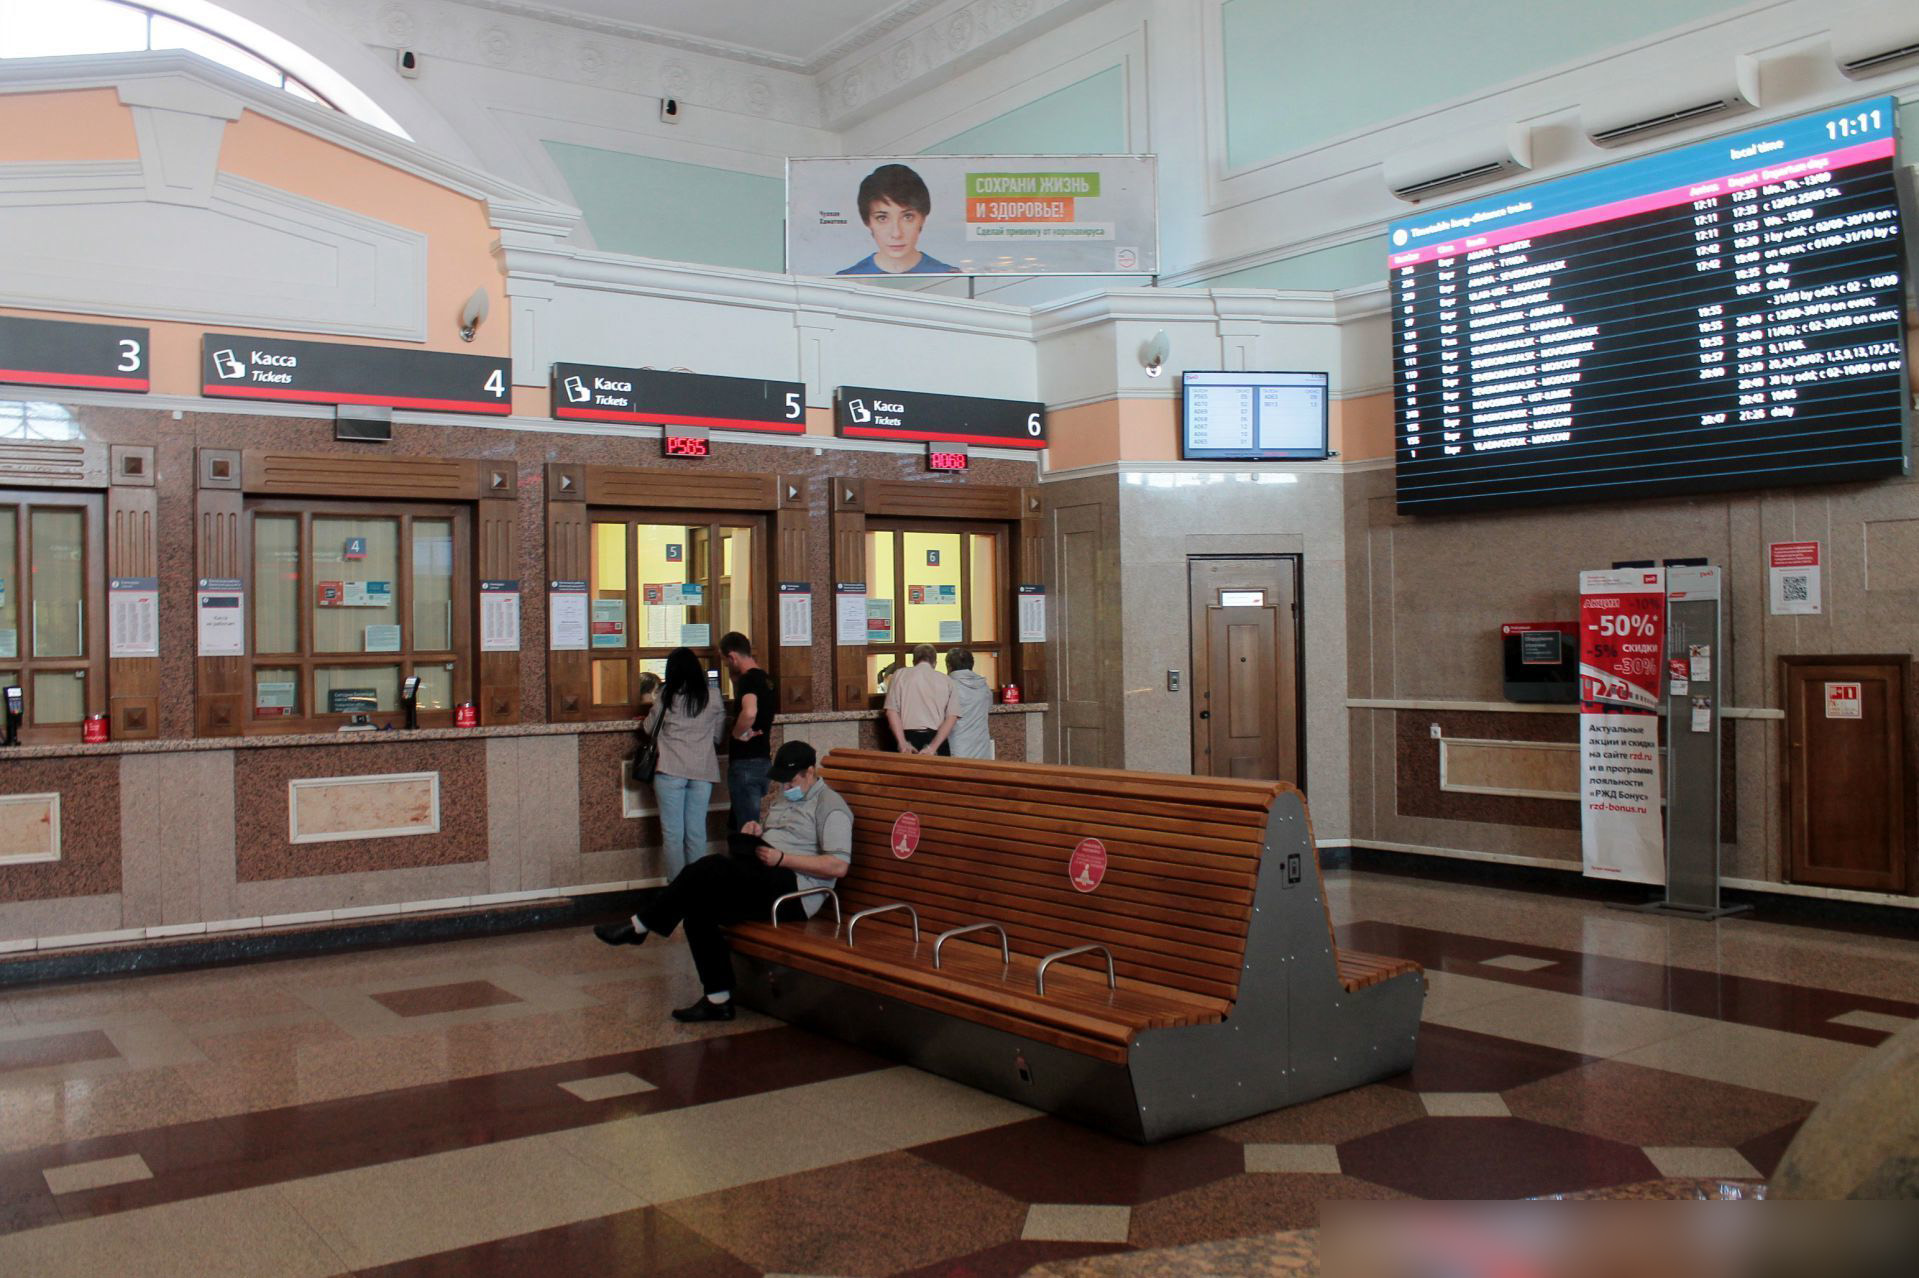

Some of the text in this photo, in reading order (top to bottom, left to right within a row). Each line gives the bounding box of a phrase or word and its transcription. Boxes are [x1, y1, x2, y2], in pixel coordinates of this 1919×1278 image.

[1826, 110, 1881, 140] 11:11
[1730, 140, 1784, 160] local time
[976, 178, 1090, 192] СОХРАНИ ЖИЗНЬ
[1732, 187, 1757, 201] 17:33
[1694, 197, 1717, 210] 17:11
[976, 202, 1064, 220] И ЗДОРОВЬЕ!
[1733, 204, 1758, 217] 17:33
[1695, 213, 1717, 225] 17:11
[976, 226, 1004, 236] Сделай
[1006, 228, 1040, 237] прививку
[1053, 228, 1105, 238] коронавируса
[1410, 222, 1450, 238] Timetable
[1733, 220, 1758, 232] 17:33
[1771, 232, 1783, 242] by
[1876, 210, 1891, 220] on
[1695, 228, 1718, 240] 17:11
[1765, 249, 1778, 258] on
[1874, 227, 1888, 238] by
[1467, 248, 1494, 260] ANAPA
[1696, 243, 1720, 256] 17:42
[1468, 254, 1527, 274] ANAPA TYNDA
[1697, 259, 1720, 271] 17:42
[1766, 262, 1789, 273] daily
[1468, 275, 1495, 287] ANAPA
[1513, 277, 1551, 292] MOSCOW
[1767, 277, 1790, 289] daily
[1801, 290, 1813, 301] by
[1469, 302, 1496, 314] TYNDA
[1832, 301, 1846, 311] on
[1854, 315, 1868, 324] on
[118, 340, 140, 372] 3
[252, 350, 296, 368] Касса
[1542, 358, 1580, 371] MOSCOW
[252, 370, 292, 384] Tickets
[1542, 372, 1580, 386] MOSCOW
[1781, 374, 1794, 384] by
[1872, 362, 1886, 371] on
[484, 370, 505, 398] 4
[594, 377, 632, 392] Касса
[596, 395, 628, 406] Tickets
[786, 393, 800, 418] 5
[874, 400, 904, 413] Касса
[1533, 402, 1571, 415] MOSCOW
[1771, 405, 1794, 417] daily
[874, 416, 902, 426] Tickets
[1027, 412, 1041, 436] 6
[1534, 417, 1572, 429] MOSCOW
[1474, 431, 1570, 450] VLADIVOSTOK MOSCOW
[352, 540, 360, 552] 4
[670, 546, 678, 558] 5
[930, 552, 936, 562] 6
[1586, 644, 1618, 658] -5%
[1614, 658, 1656, 676] -30%
[1589, 724, 1644, 735] Актуальные
[1589, 738, 1619, 748] акции
[1628, 740, 1656, 749] скидки
[1603, 752, 1628, 760] сайте
[1630, 752, 1652, 761] rzd.ru
[1606, 767, 1654, 776] программе
[1590, 778, 1644, 788] лояльности
[1590, 790, 1648, 801] «РЖД Бонус»
[1590, 804, 1647, 814] rzd-bonus.ru
